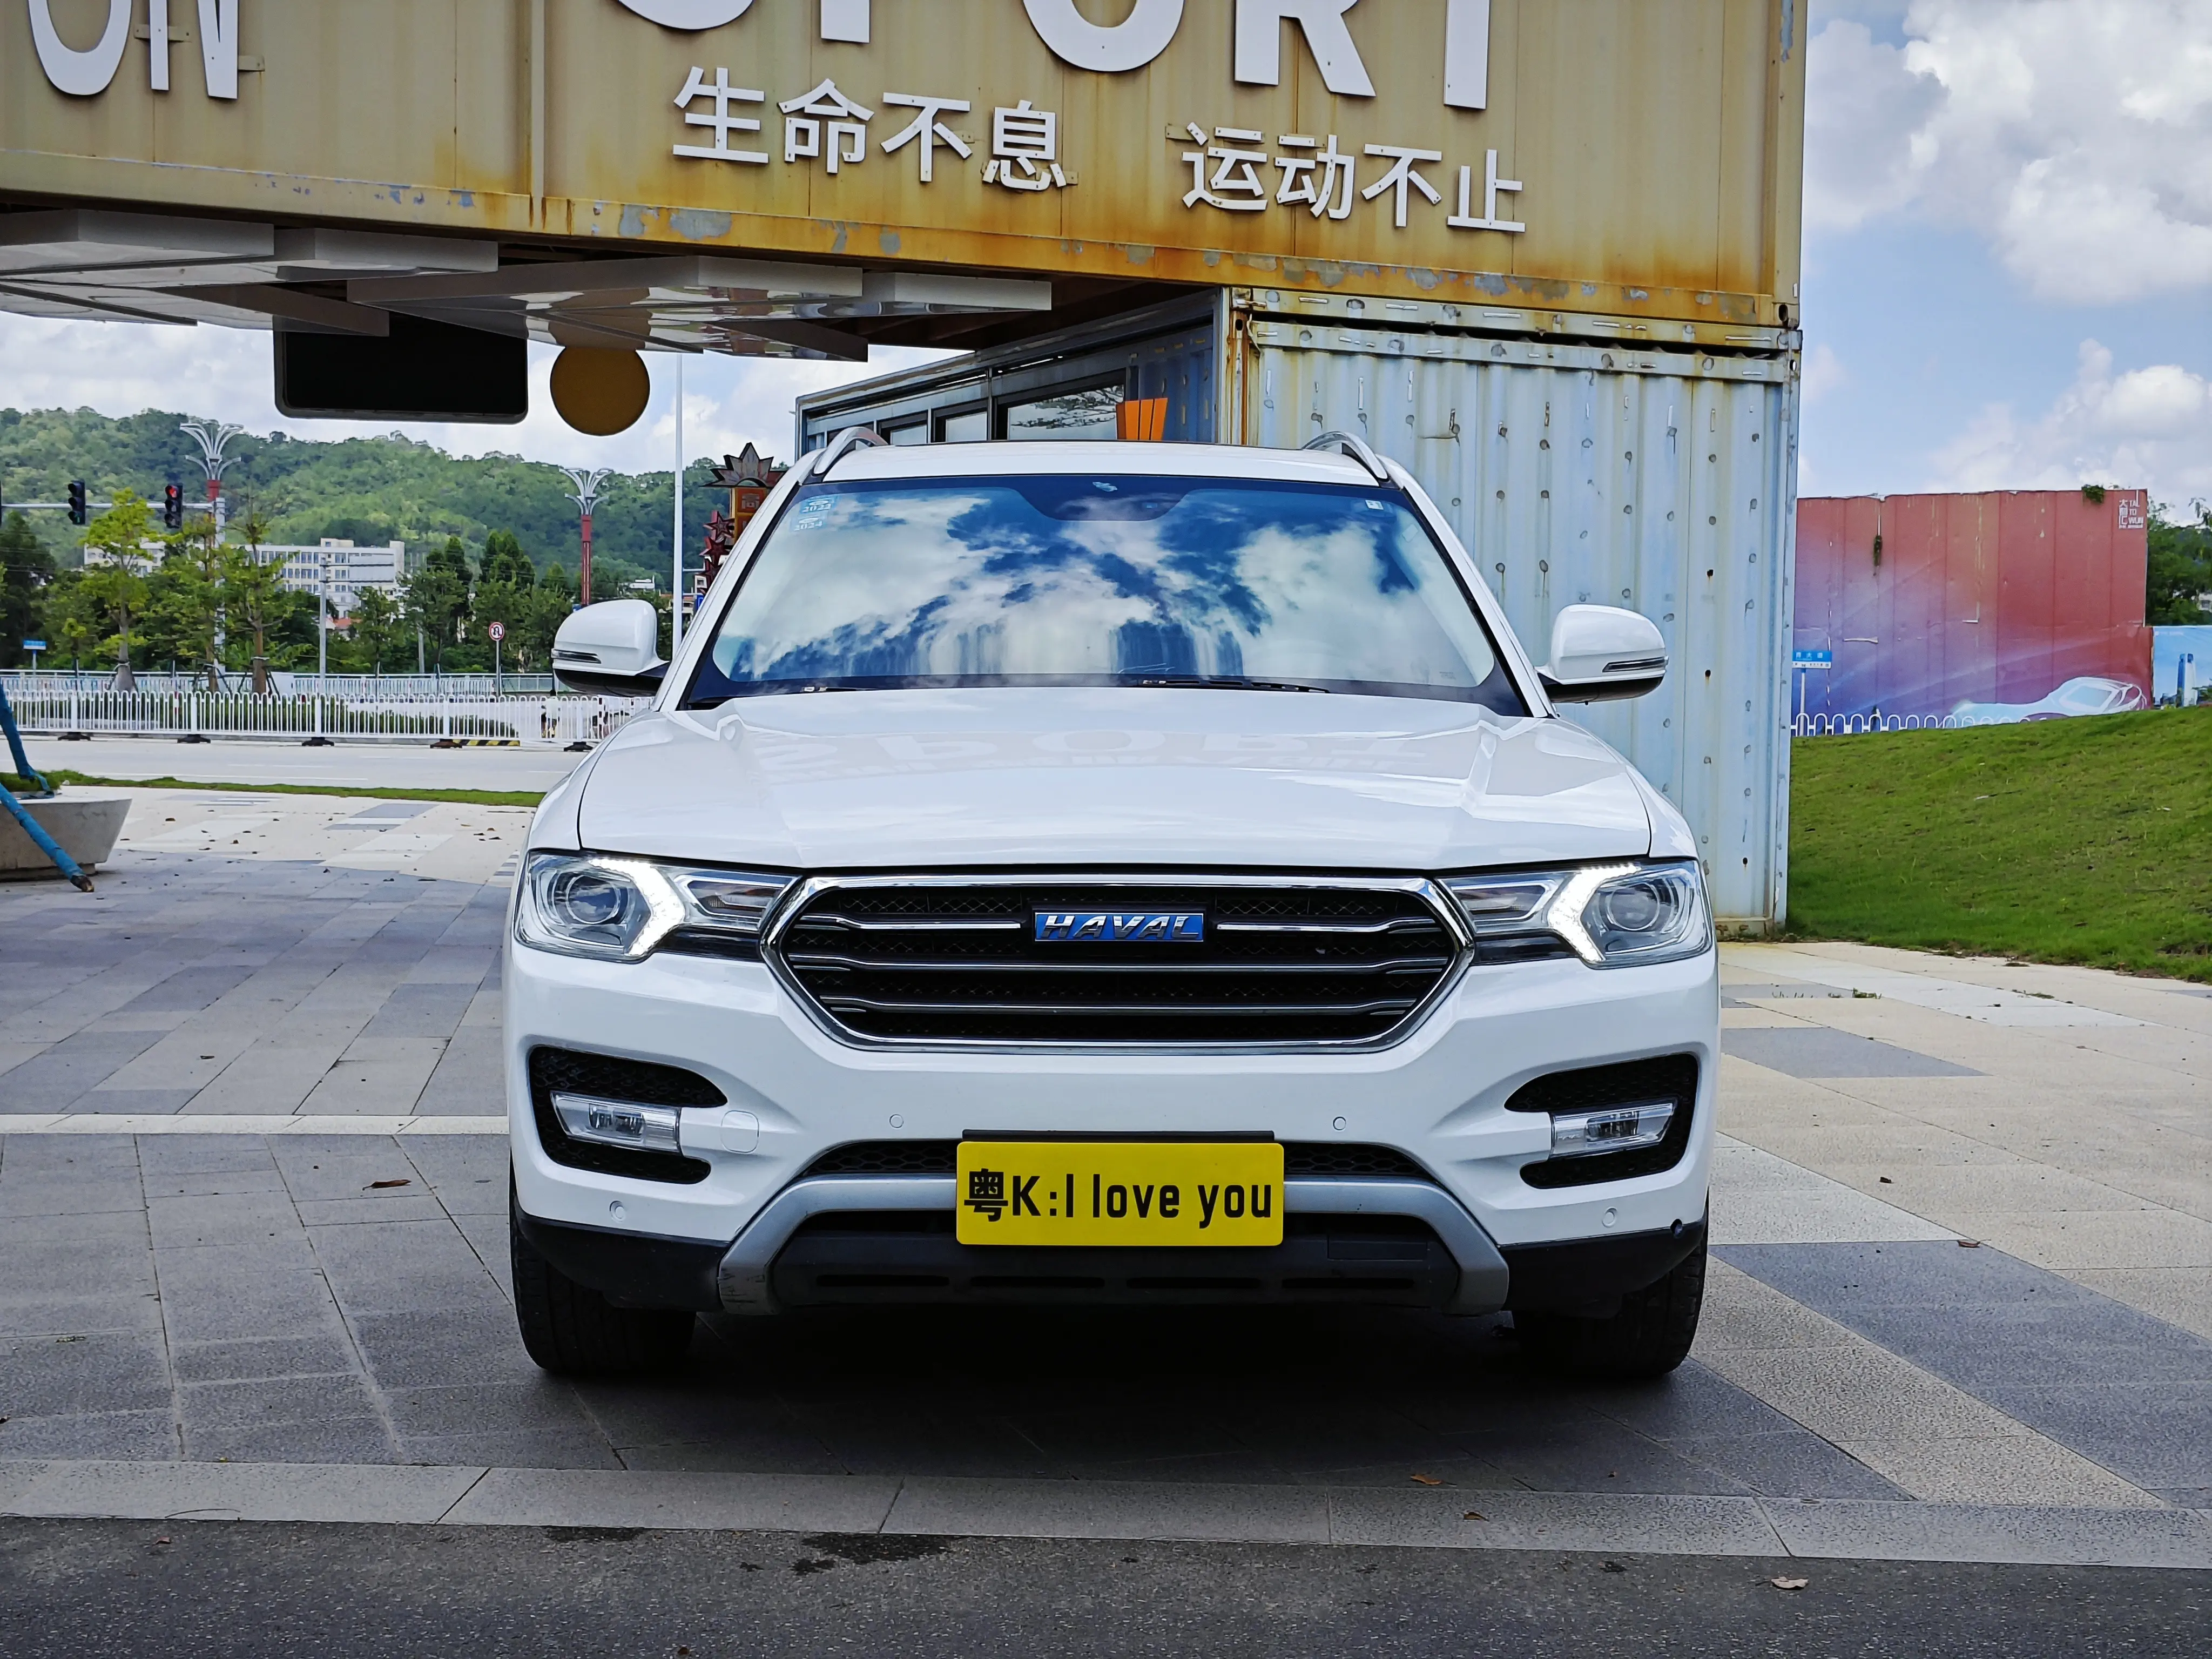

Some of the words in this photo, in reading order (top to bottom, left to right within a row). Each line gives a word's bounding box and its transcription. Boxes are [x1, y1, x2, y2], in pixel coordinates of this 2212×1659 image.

[672, 66, 1066, 192] 生命不息
[1182, 122, 1526, 233] 运动不止
[1041, 915, 1199, 939] HAVAL
[1092, 1174, 1180, 1218] love
[1197, 1184, 1271, 1229] you
